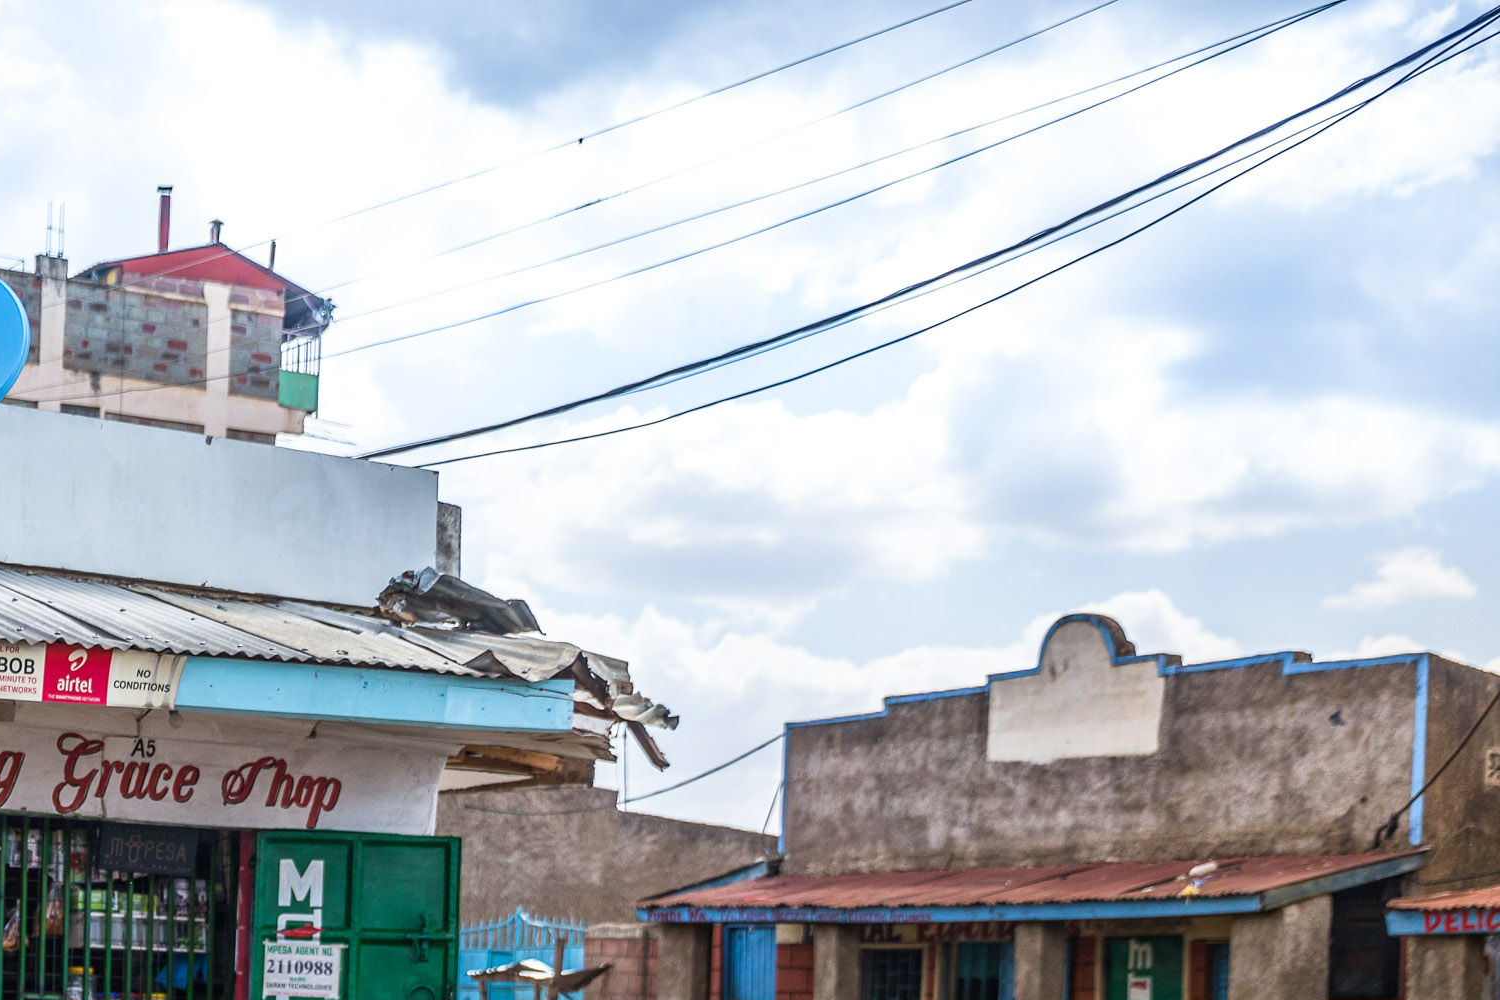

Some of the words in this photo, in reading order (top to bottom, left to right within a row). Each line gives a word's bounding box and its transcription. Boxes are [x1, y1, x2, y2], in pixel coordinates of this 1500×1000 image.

[5, 645, 20, 654] FOR
[0, 675, 26, 684] MINUTE
[28, 677, 37, 685] TO
[136, 668, 151, 679] NO
[56, 673, 93, 694] airtel
[113, 680, 171, 693] CONDITIONS
[131, 739, 156, 758] A5
[52, 732, 200, 814] Grace
[221, 756, 342, 829] Shop
[267, 945, 292, 955] MPESA
[295, 947, 319, 956] AGENT
[266, 959, 333, 976] 2110988
